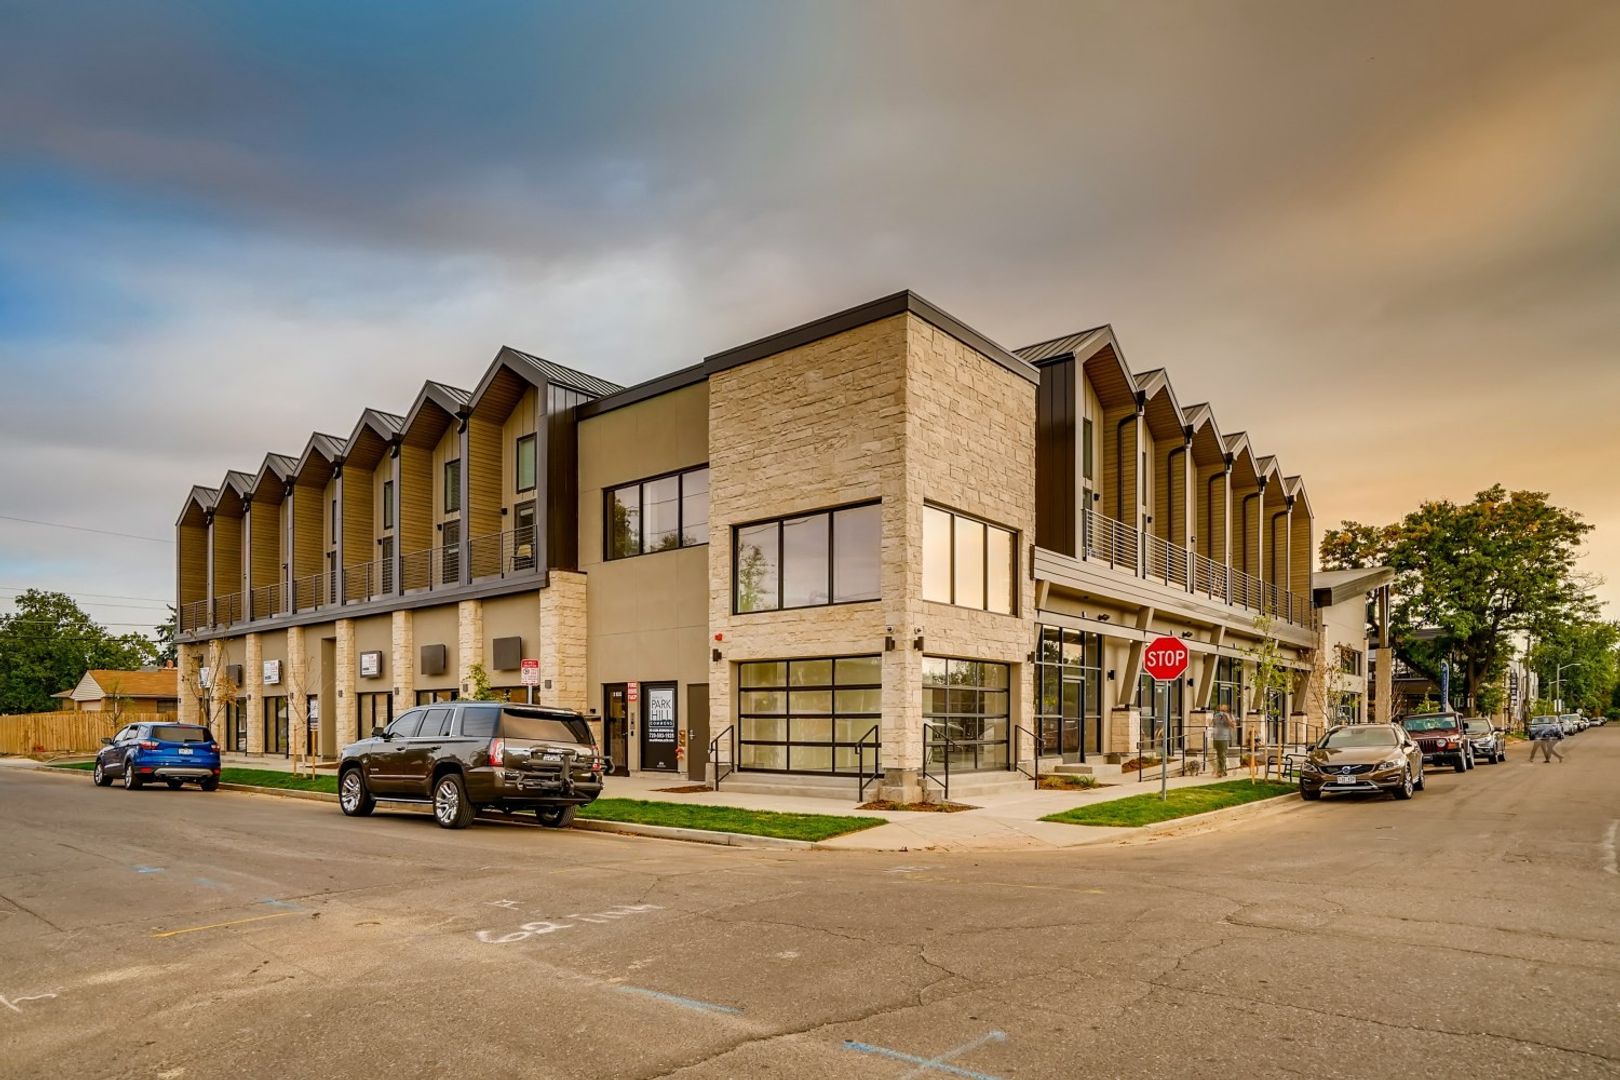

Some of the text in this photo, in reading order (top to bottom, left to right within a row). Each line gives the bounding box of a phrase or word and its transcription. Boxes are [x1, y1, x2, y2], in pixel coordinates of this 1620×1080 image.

[1147, 650, 1185, 667] STOP
[651, 699, 671, 709] PARK
[651, 709, 671, 720] HILL
